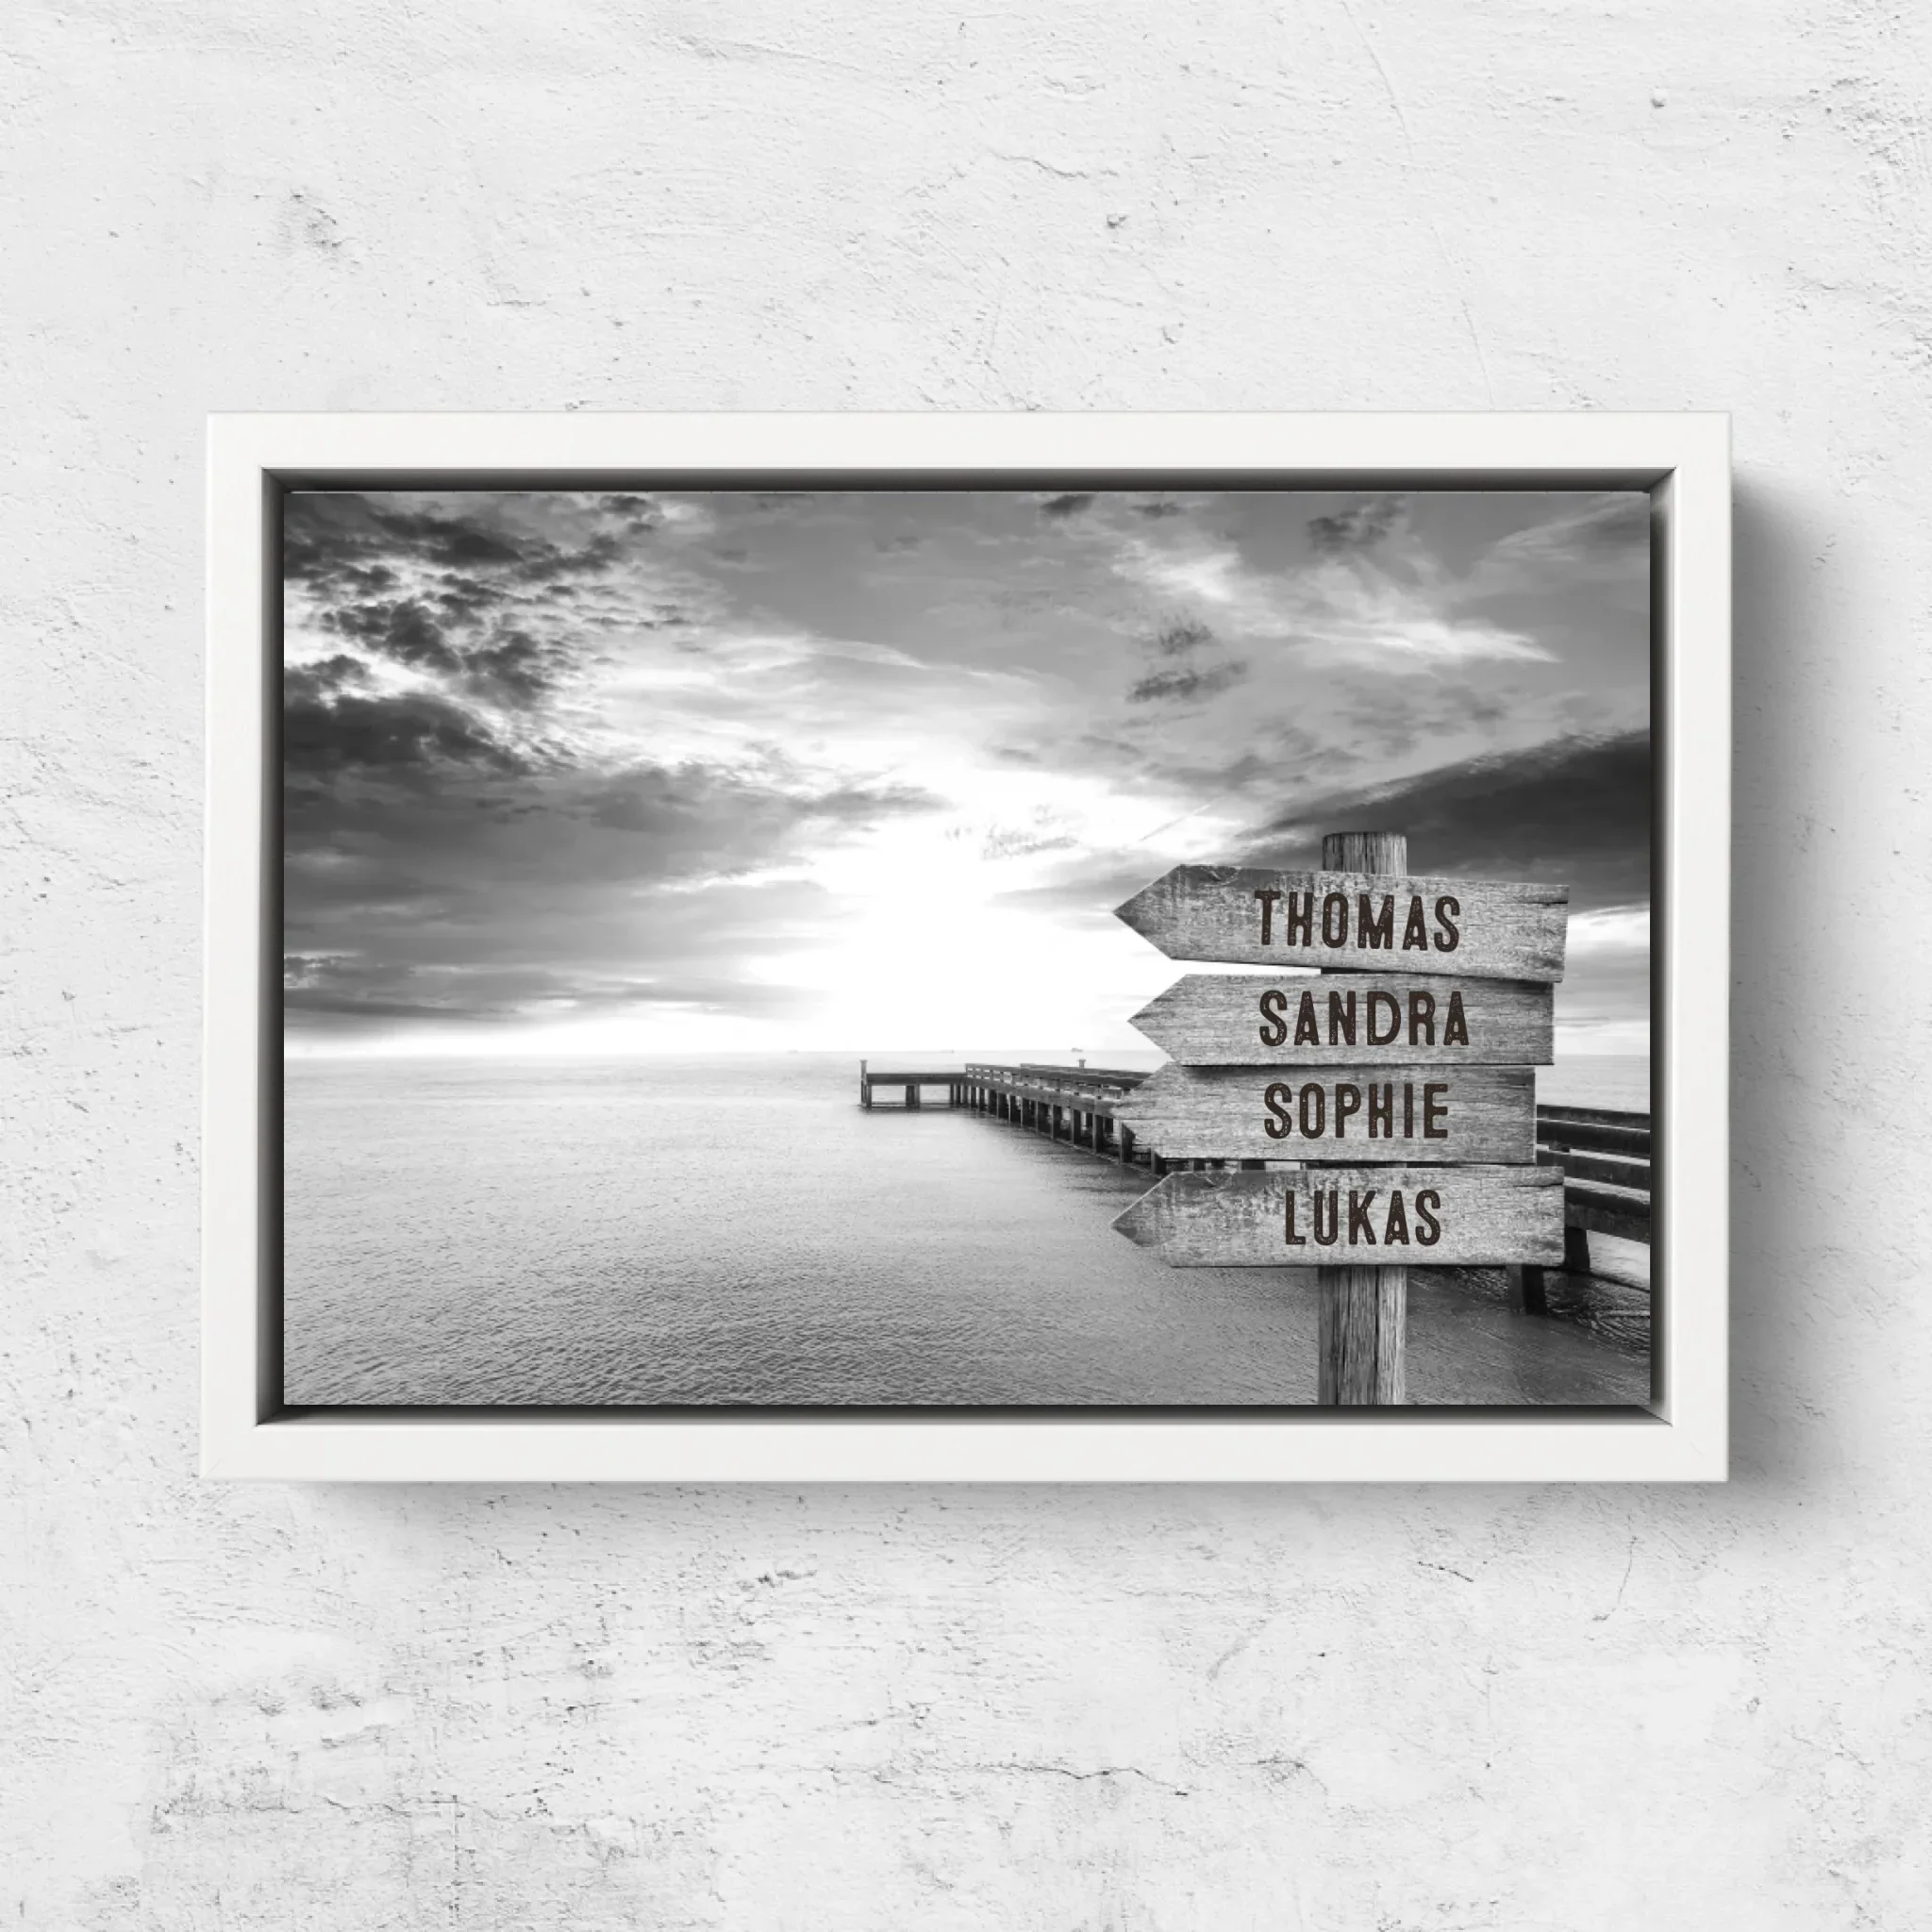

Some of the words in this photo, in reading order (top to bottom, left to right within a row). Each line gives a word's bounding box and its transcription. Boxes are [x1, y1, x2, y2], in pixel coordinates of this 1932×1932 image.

[1255, 890, 1461, 953] THOMAS
[1258, 990, 1470, 1047] SANDRA
[1263, 1082, 1450, 1140] SOPHIE
[1284, 1189, 1442, 1246] LUKAS
